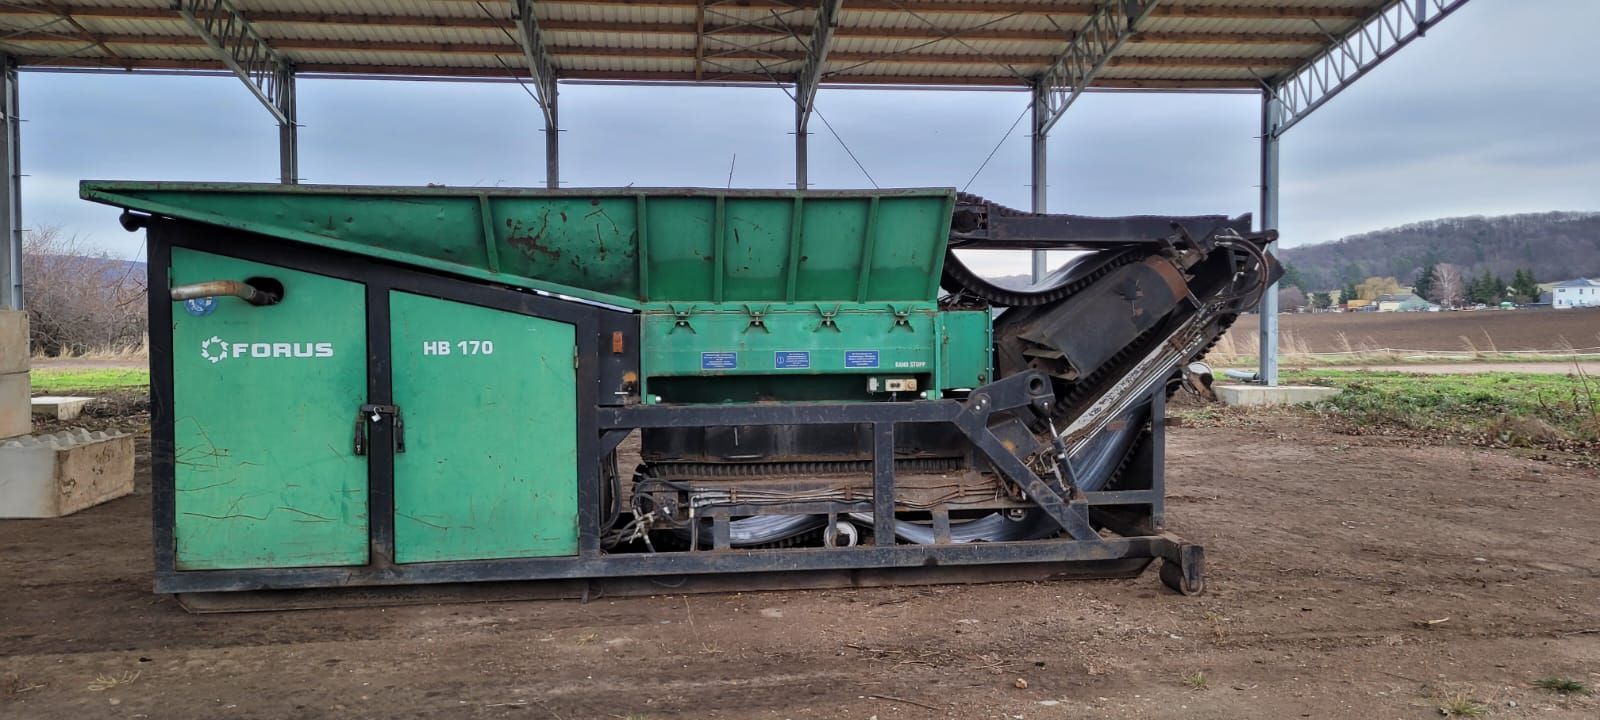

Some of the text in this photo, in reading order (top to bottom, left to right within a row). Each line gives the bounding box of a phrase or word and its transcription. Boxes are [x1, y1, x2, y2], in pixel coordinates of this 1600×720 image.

[232, 343, 334, 358] FORUS
[423, 340, 494, 356] HB 170
